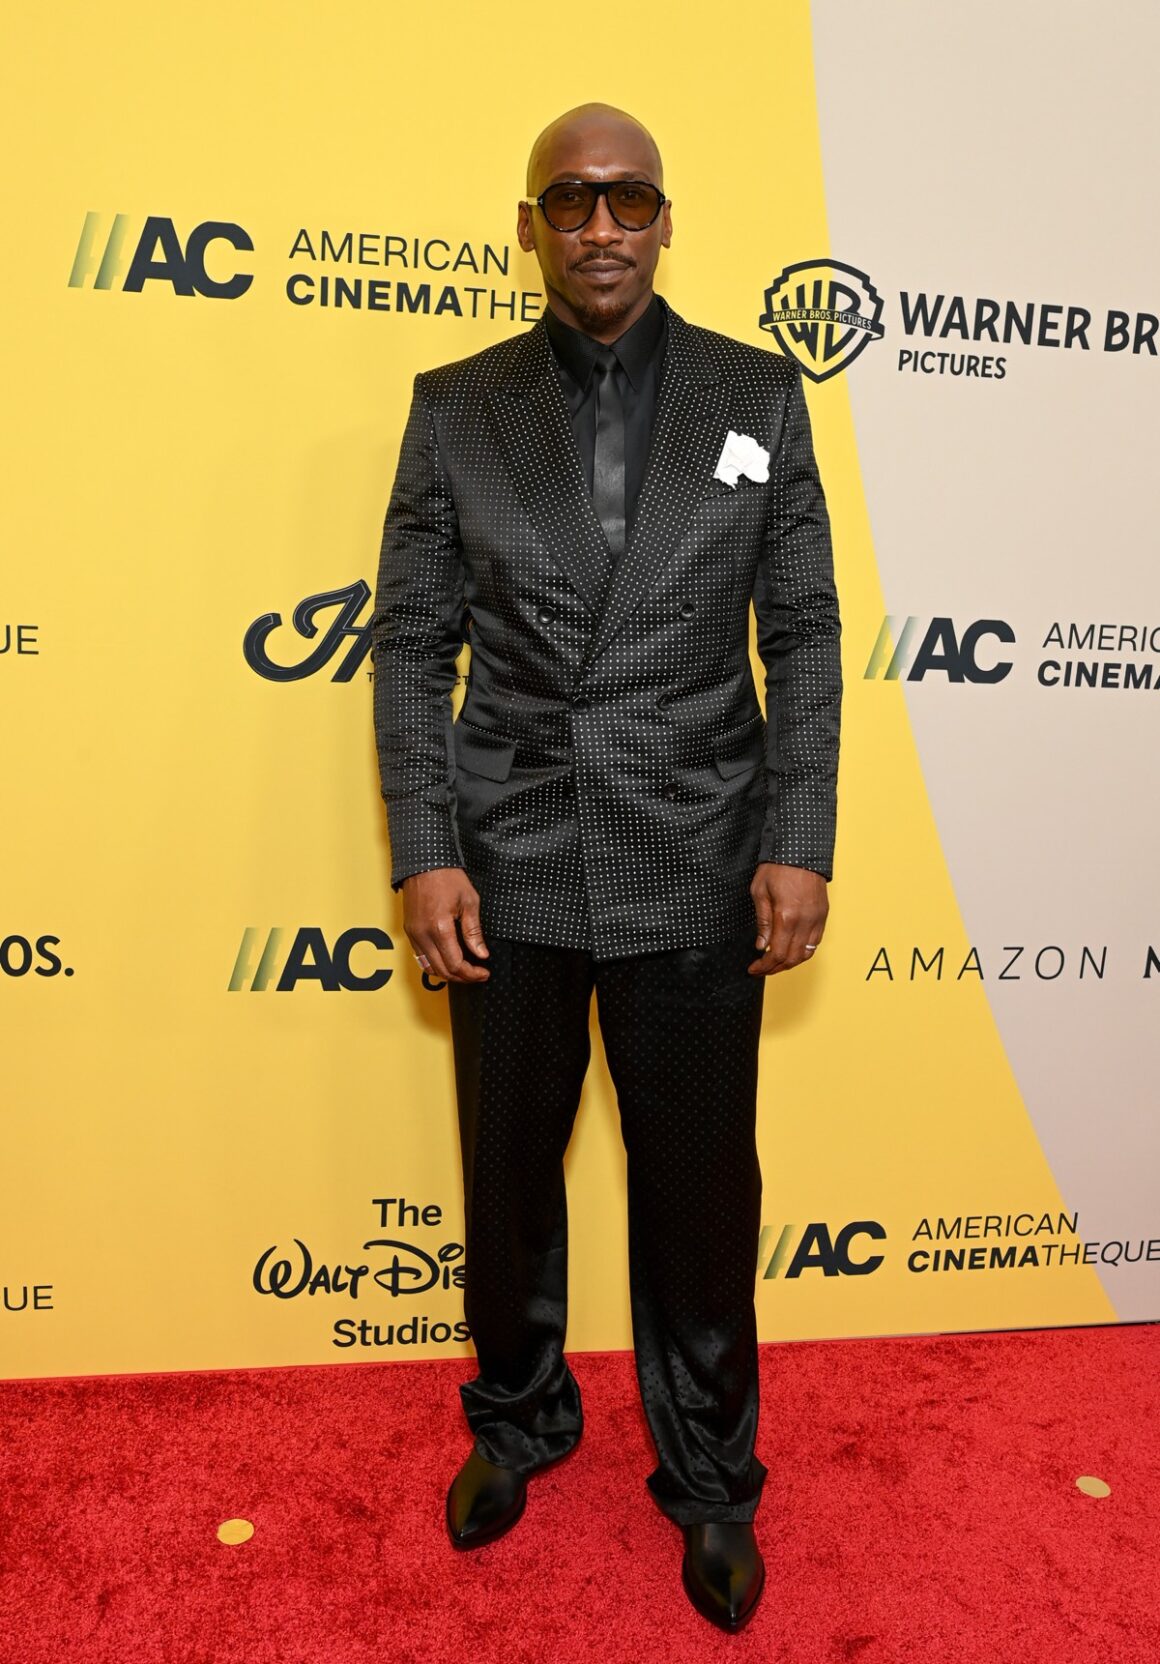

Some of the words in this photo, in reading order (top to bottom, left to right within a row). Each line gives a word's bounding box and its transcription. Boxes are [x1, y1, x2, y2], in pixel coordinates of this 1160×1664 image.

[288, 228, 510, 275] AMERICAN
[284, 274, 542, 322] CINEMATHE
[773, 311, 806, 321] WARNER
[810, 310, 832, 320] BROS.
[834, 313, 872, 330] PICTURES
[900, 291, 1092, 350] WARNER
[1103, 309, 1160, 357] BR
[898, 349, 1006, 380] PICTURES
[1038, 660, 1160, 690] CINEM
[0, 935, 74, 976] OS.
[866, 946, 1107, 980] AMAZON
[372, 1199, 442, 1226] The
[912, 1213, 1078, 1240] AMERICAN
[908, 1240, 1160, 1272] CINEMATHEQUE
[4, 1285, 54, 1311] UE
[332, 1317, 471, 1346] Studios
